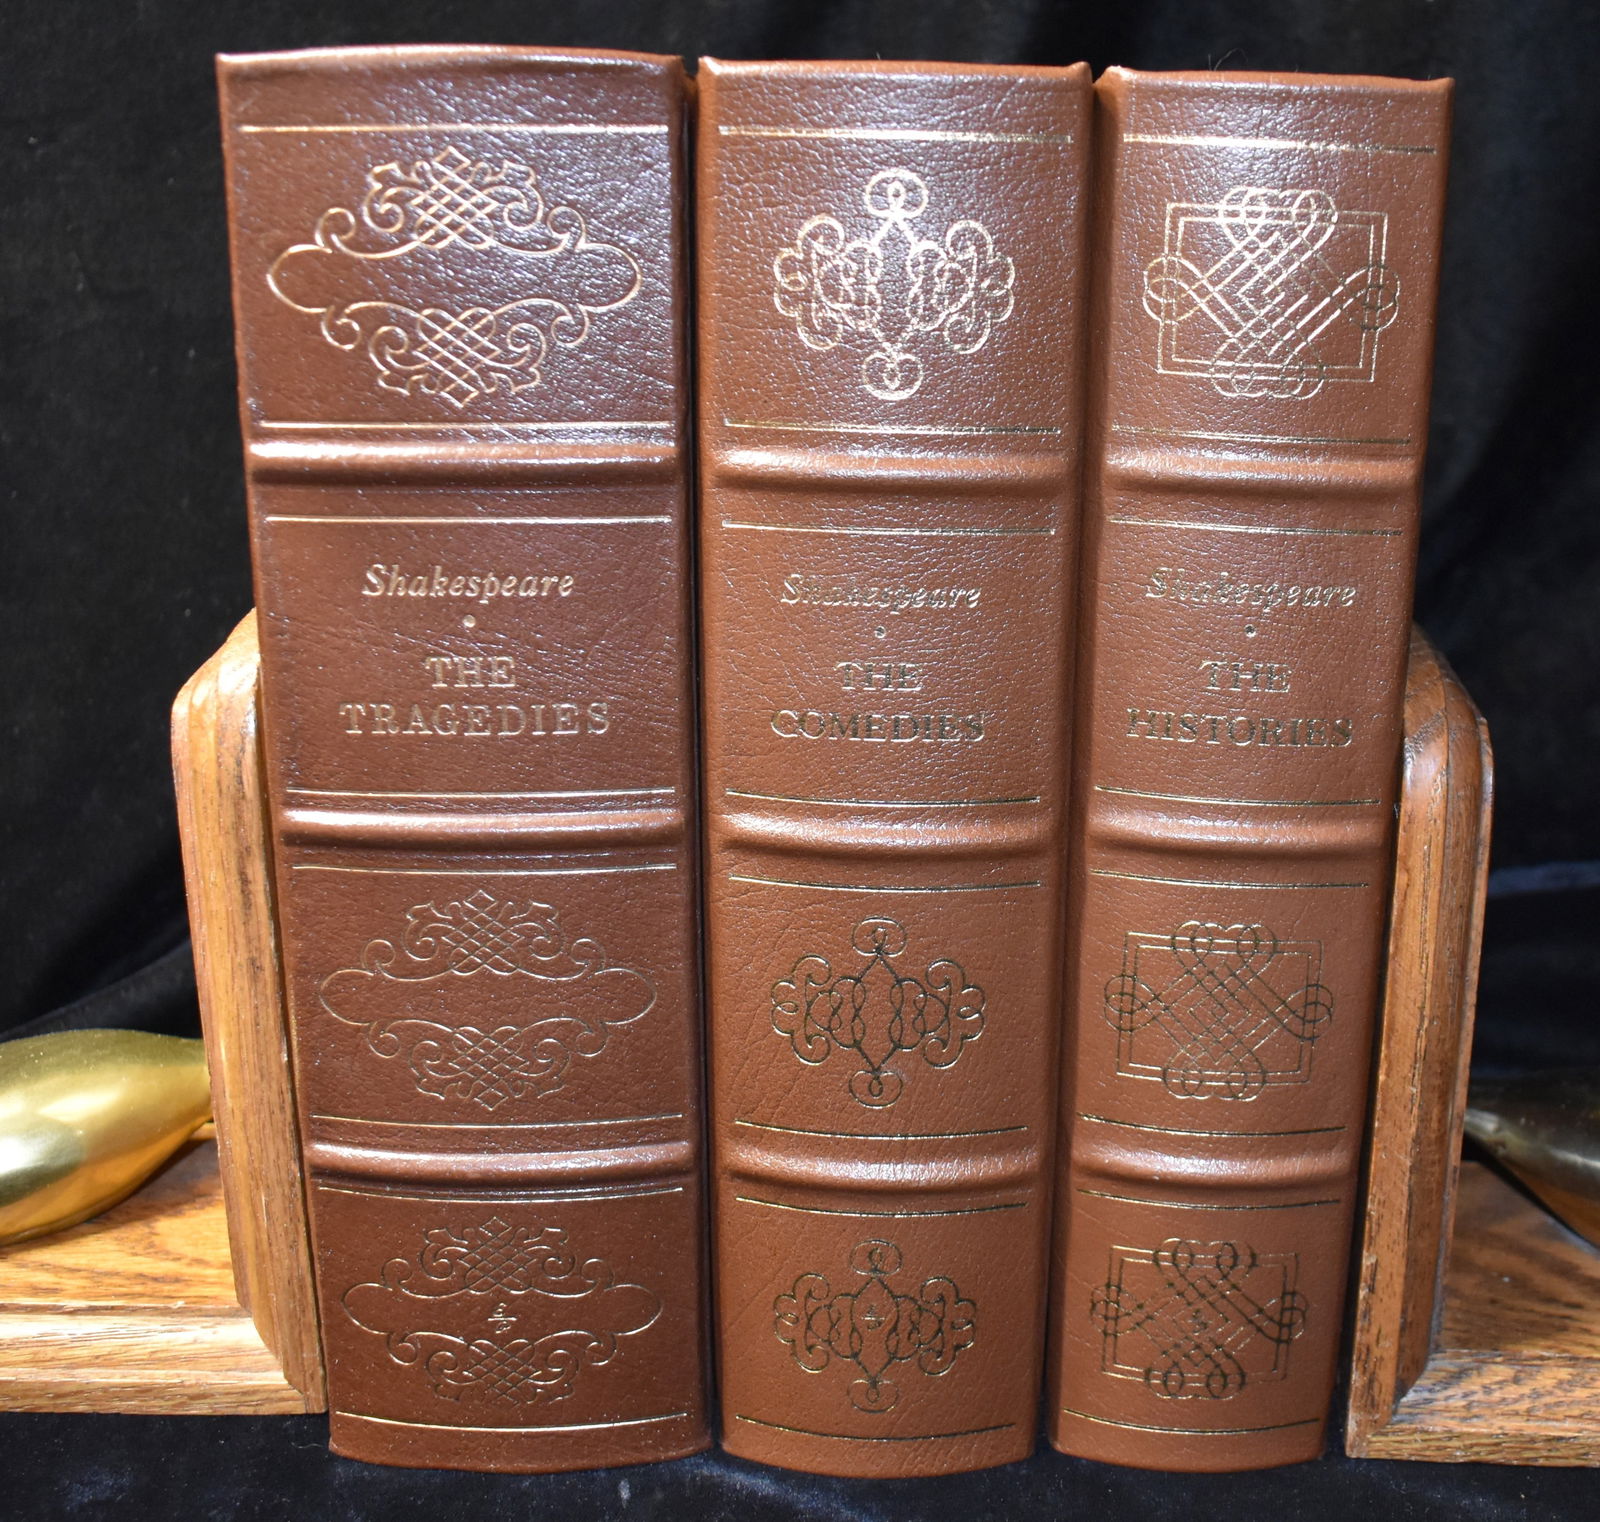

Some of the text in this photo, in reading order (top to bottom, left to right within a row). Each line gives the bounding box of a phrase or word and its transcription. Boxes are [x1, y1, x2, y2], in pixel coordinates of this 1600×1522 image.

[361, 563, 575, 604] Shakespeare
[424, 655, 516, 688] THE
[834, 660, 924, 691] THE
[1199, 659, 1293, 693] THE
[338, 701, 611, 736] TRAGEDIES
[770, 709, 986, 743] COMEDIES
[1125, 707, 1353, 748] HISTORIES
